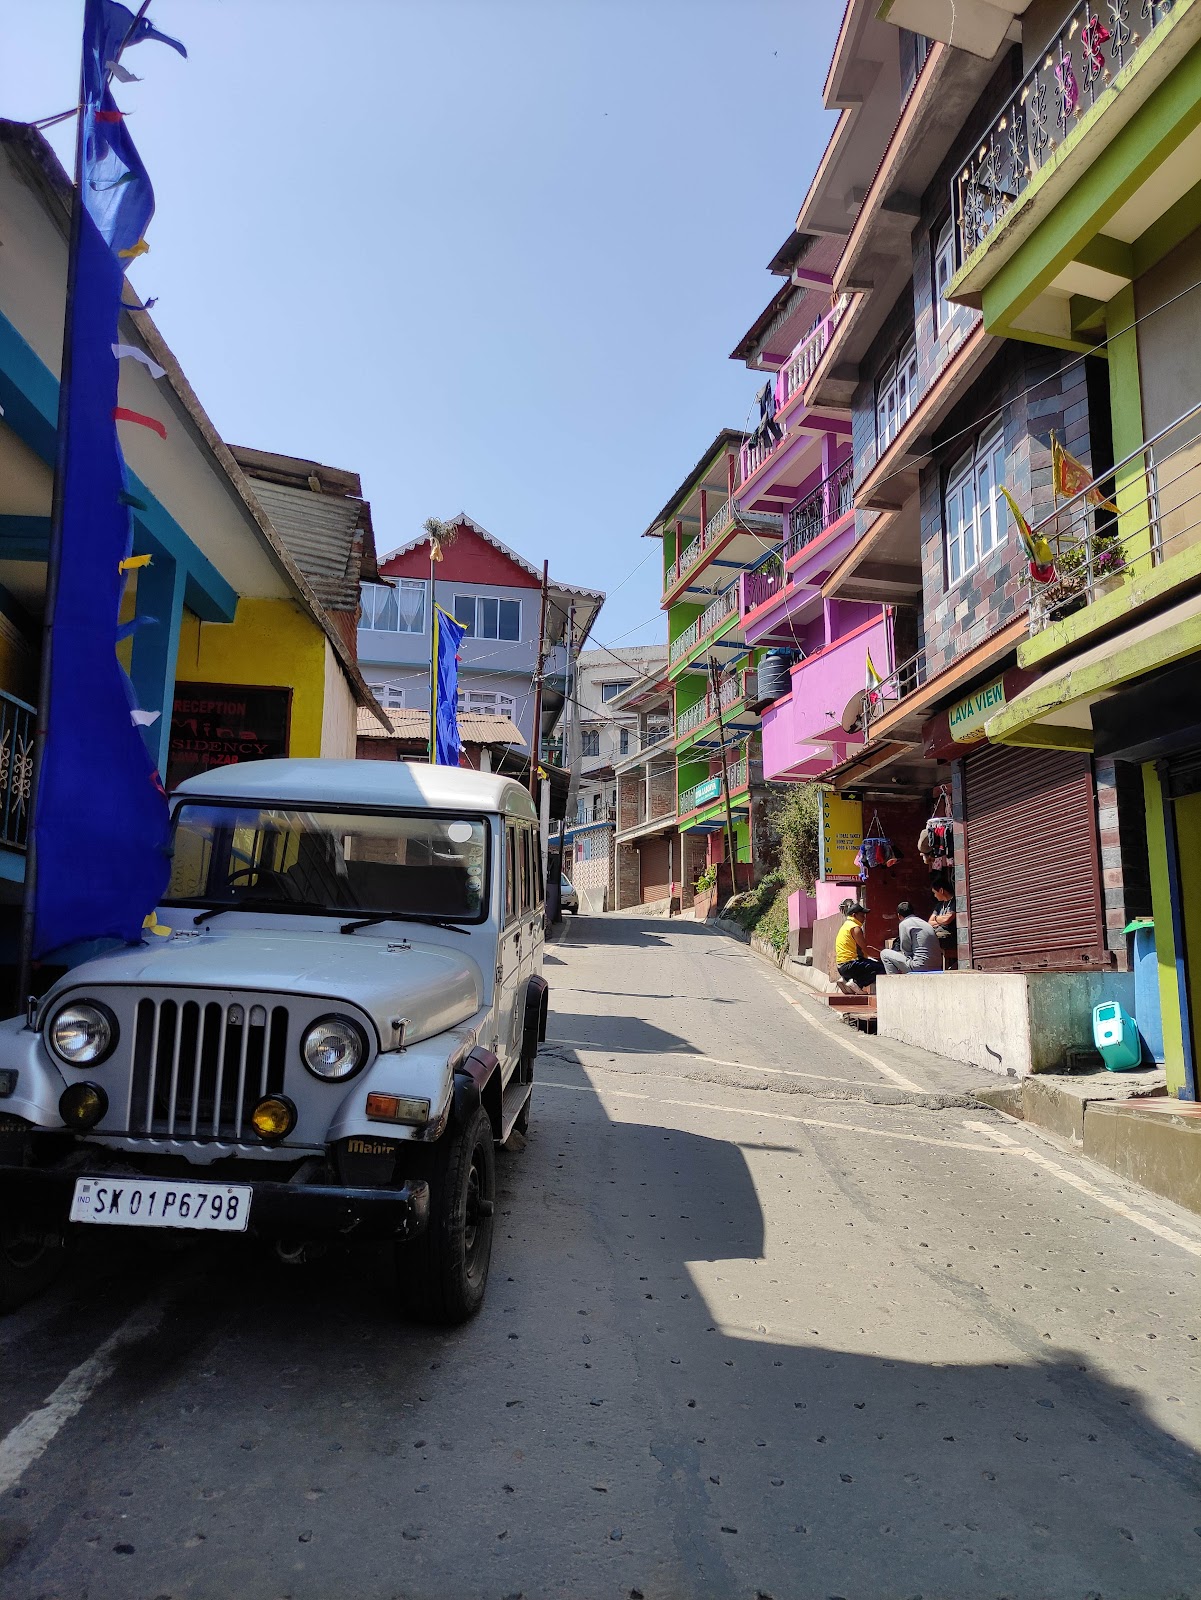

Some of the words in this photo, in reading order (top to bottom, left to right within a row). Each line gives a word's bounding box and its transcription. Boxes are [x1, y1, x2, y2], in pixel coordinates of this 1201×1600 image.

[173, 700, 245, 716] RECEPTION
[949, 698, 974, 726] LAVA
[975, 684, 1002, 711] VIEW
[825, 838, 833, 873] VIEW
[77, 1195, 91, 1204] IND
